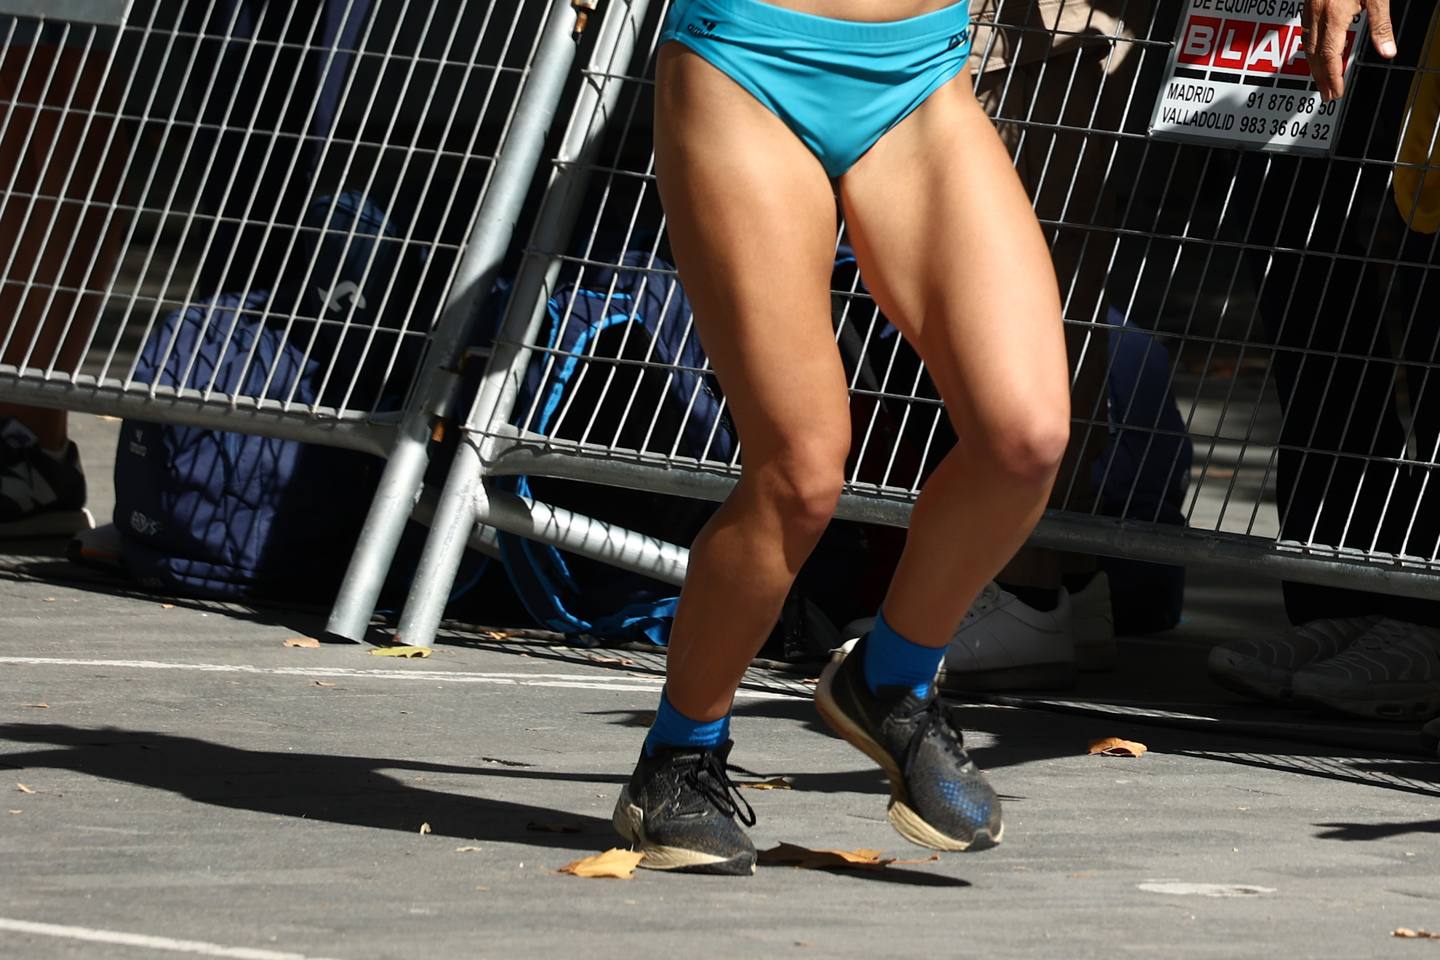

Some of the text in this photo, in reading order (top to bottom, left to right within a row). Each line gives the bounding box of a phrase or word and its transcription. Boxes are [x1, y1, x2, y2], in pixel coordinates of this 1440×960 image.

[1278, 0, 1305, 20] PAR
[1166, 83, 1336, 116] MADRID 91 876 88 50
[1162, 106, 1330, 140] VALLADOLID 983 36 04 32
